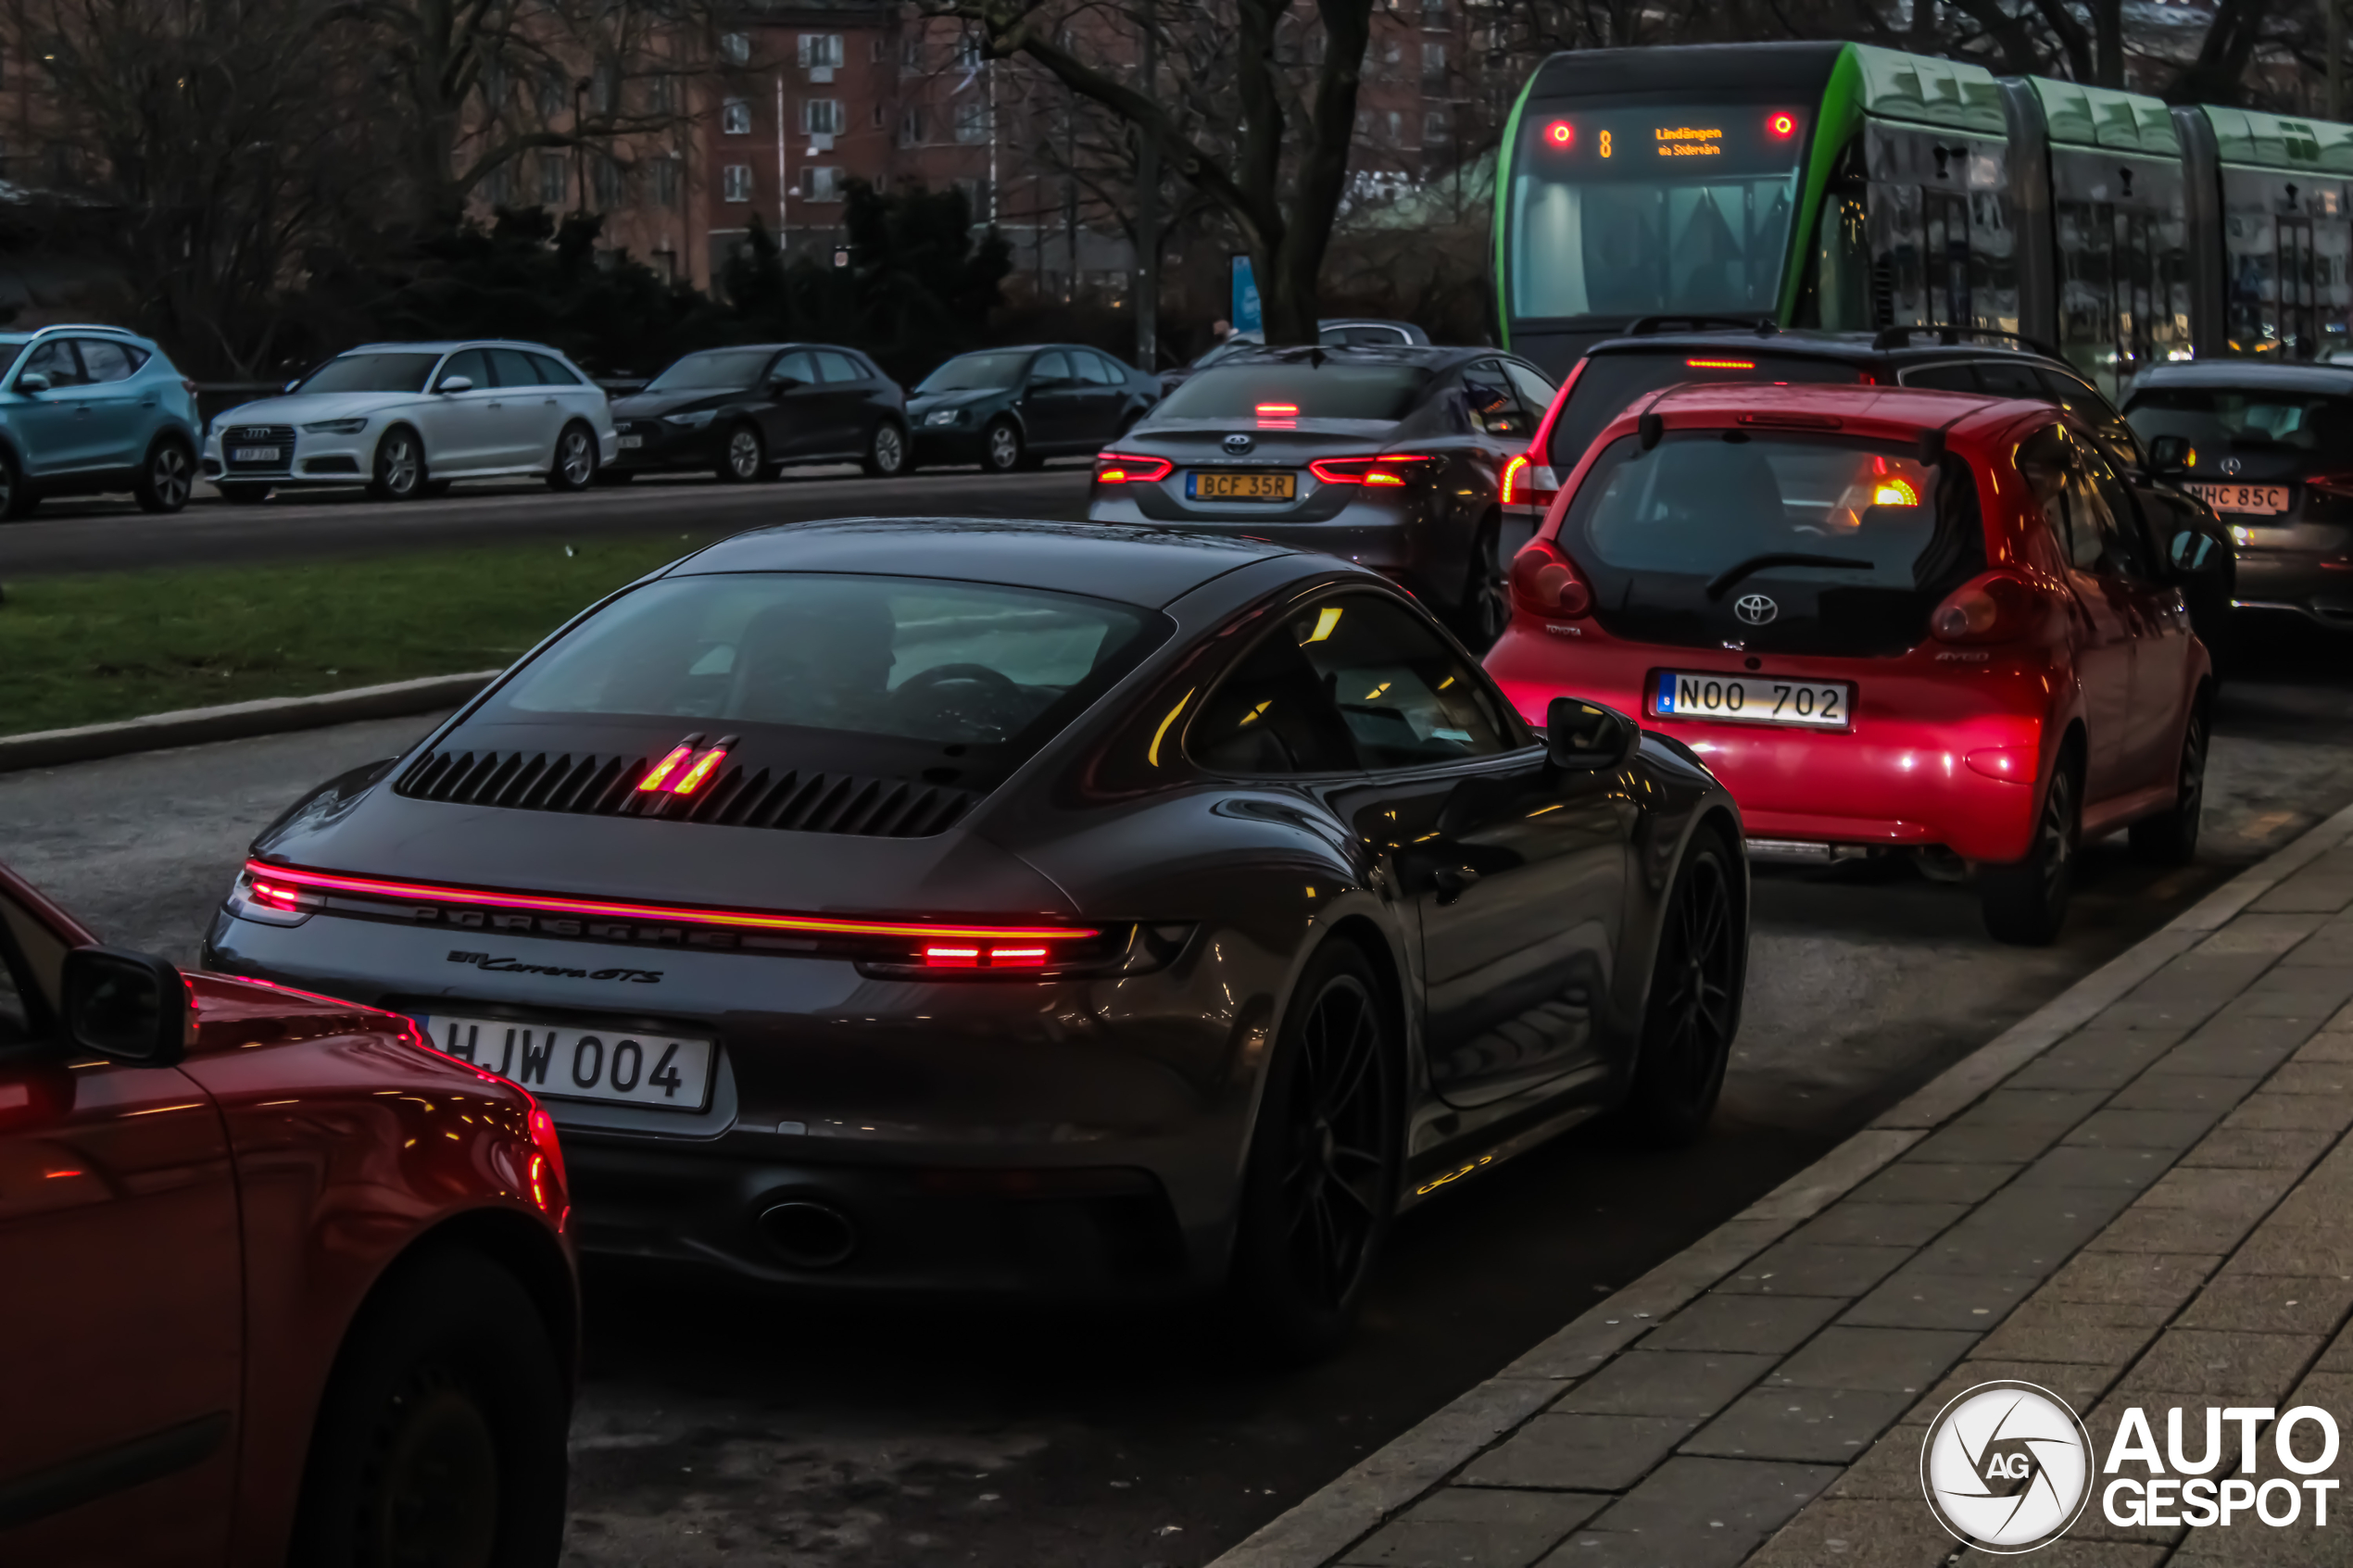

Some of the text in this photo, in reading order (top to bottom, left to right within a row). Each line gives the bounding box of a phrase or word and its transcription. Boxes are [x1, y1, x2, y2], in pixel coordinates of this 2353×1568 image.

[1600, 130, 1611, 157] 8
[1655, 127, 1722, 141] Lindängen
[1658, 144, 1672, 156] via
[1204, 476, 1286, 495] BCF 35R
[2192, 485, 2280, 508] MHC 85C
[1545, 624, 1581, 636] TOYOTA
[1664, 696, 1670, 706] S
[1680, 679, 1839, 720] NOO 702
[414, 908, 737, 947] PORSCHE
[477, 958, 586, 978] Carrera
[589, 969, 664, 983] GTS
[447, 1022, 682, 1098] HJW 004
